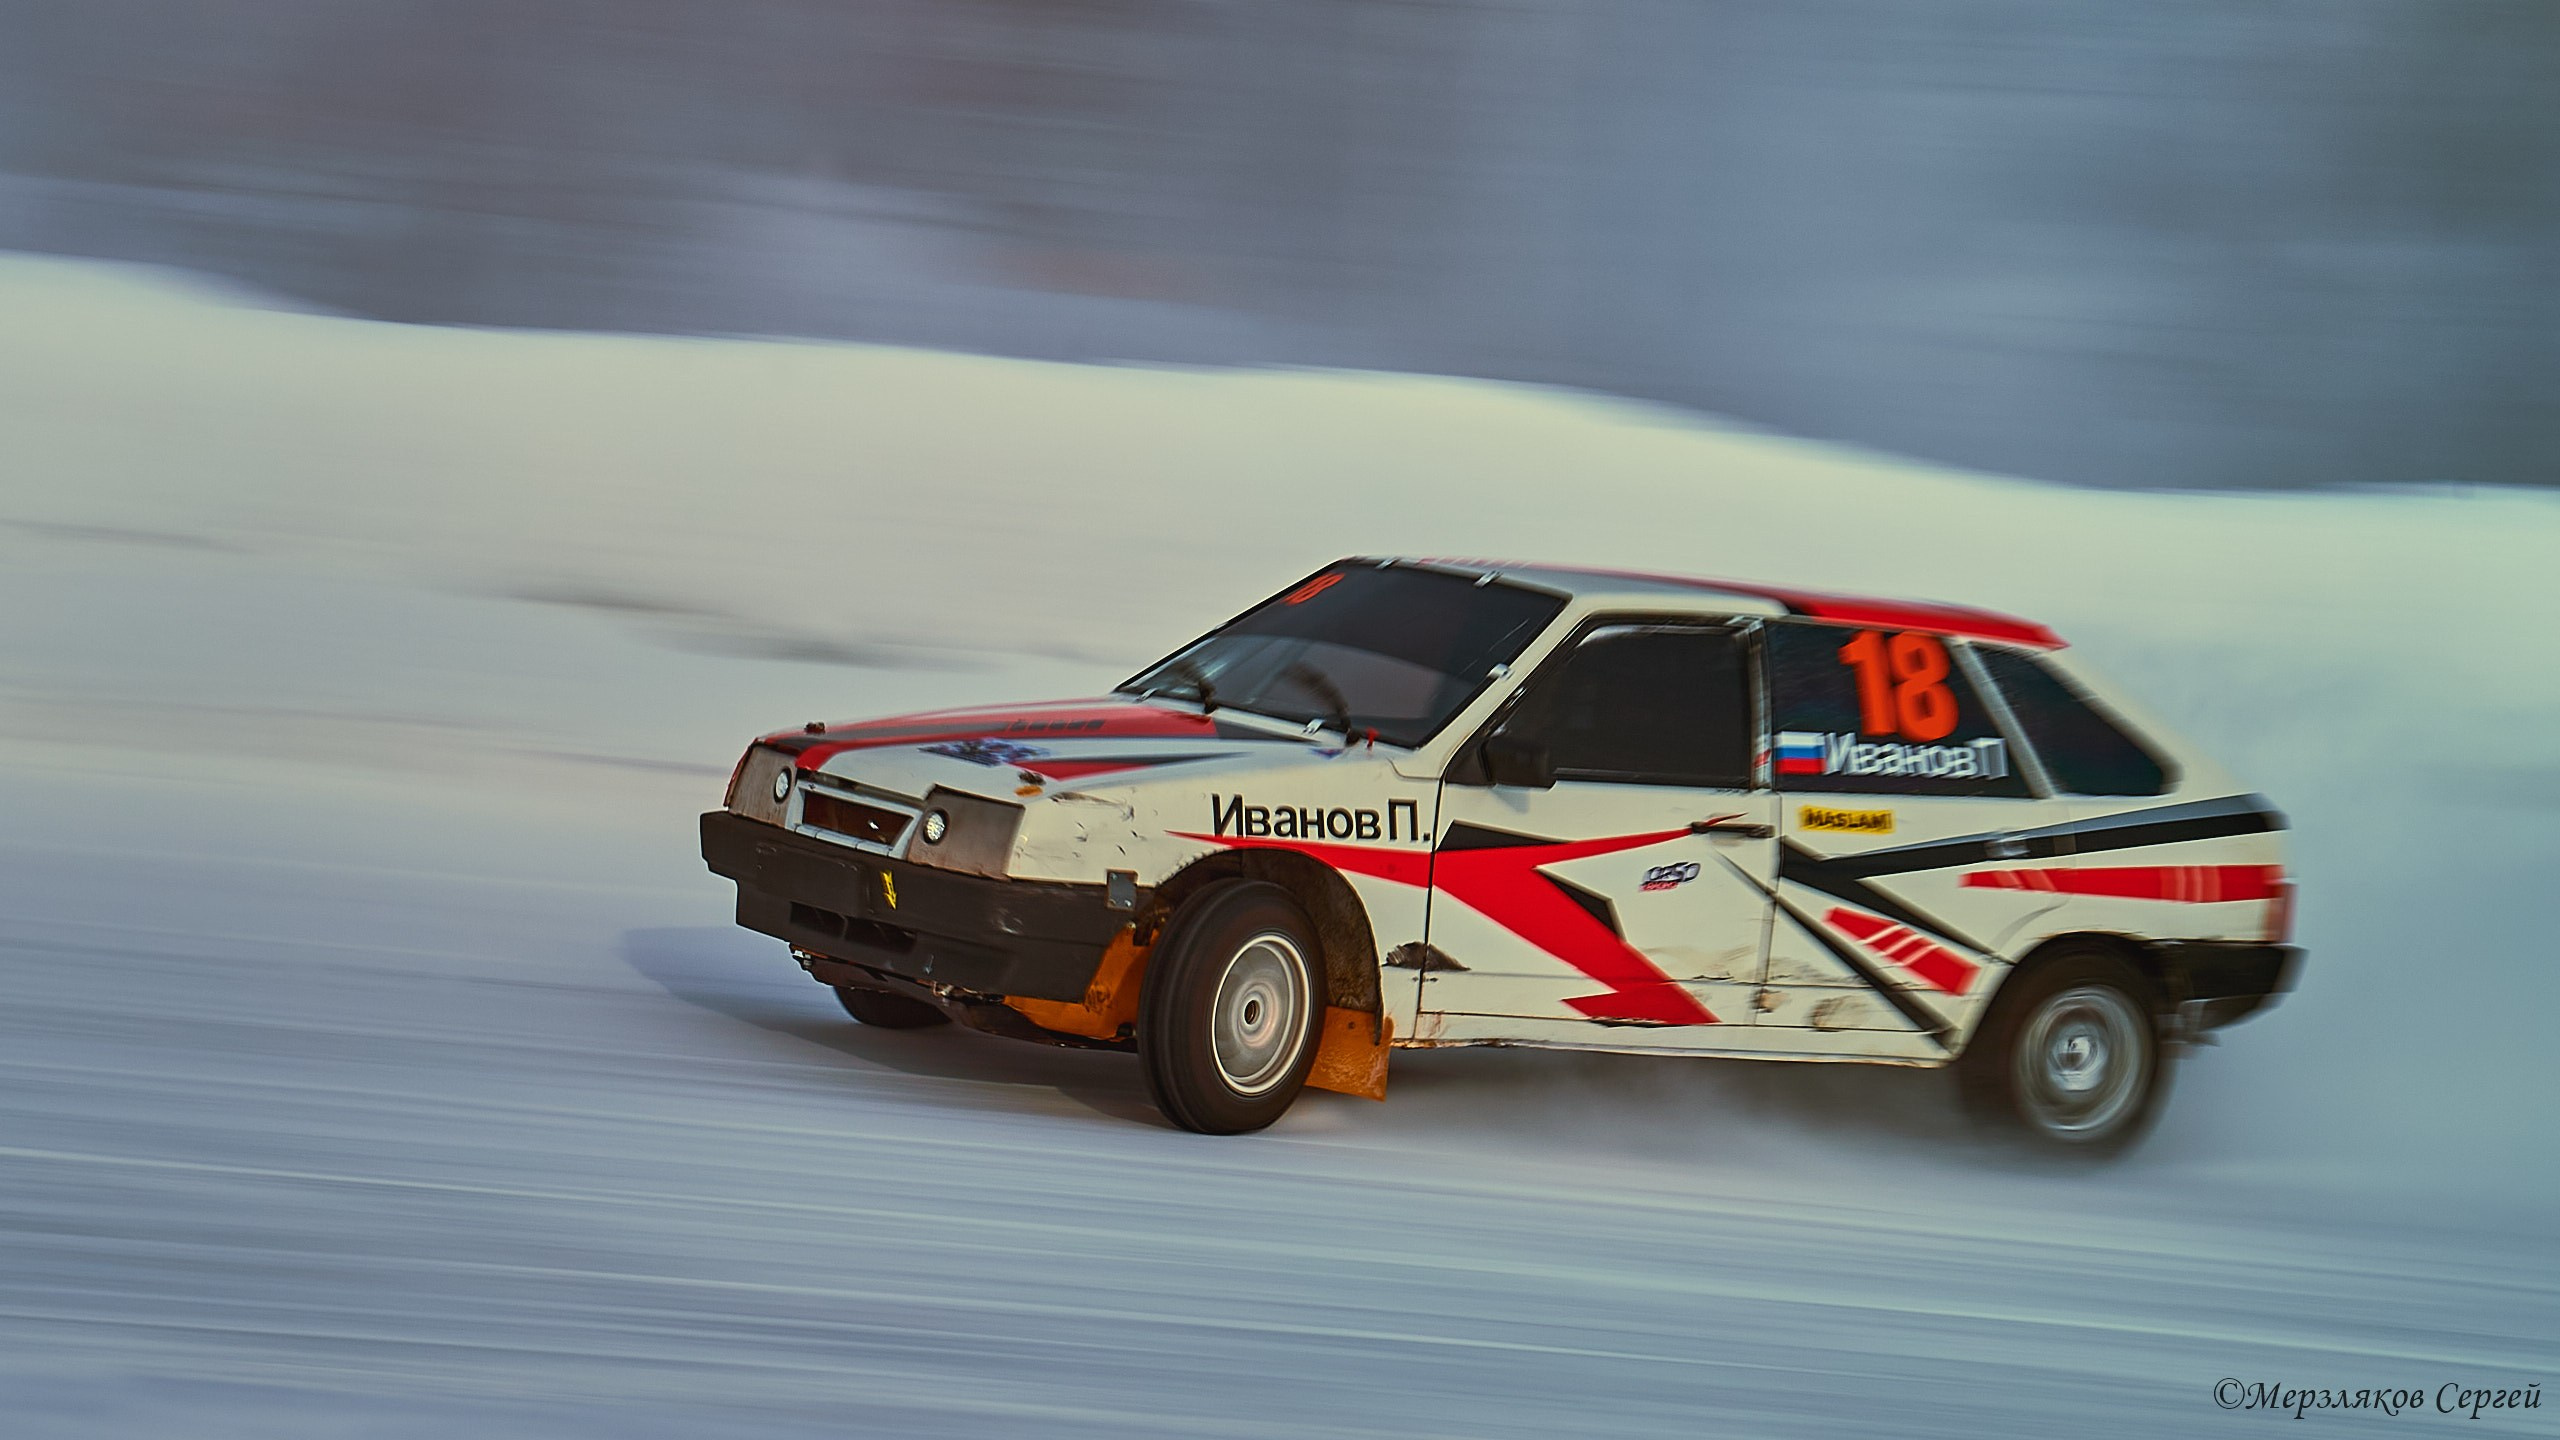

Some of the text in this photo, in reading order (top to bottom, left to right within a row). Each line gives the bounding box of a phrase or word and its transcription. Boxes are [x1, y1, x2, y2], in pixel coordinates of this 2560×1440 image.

[1281, 572, 1346, 605] 18
[1838, 629, 1959, 742] 18
[1211, 793, 1381, 841] Иванов
